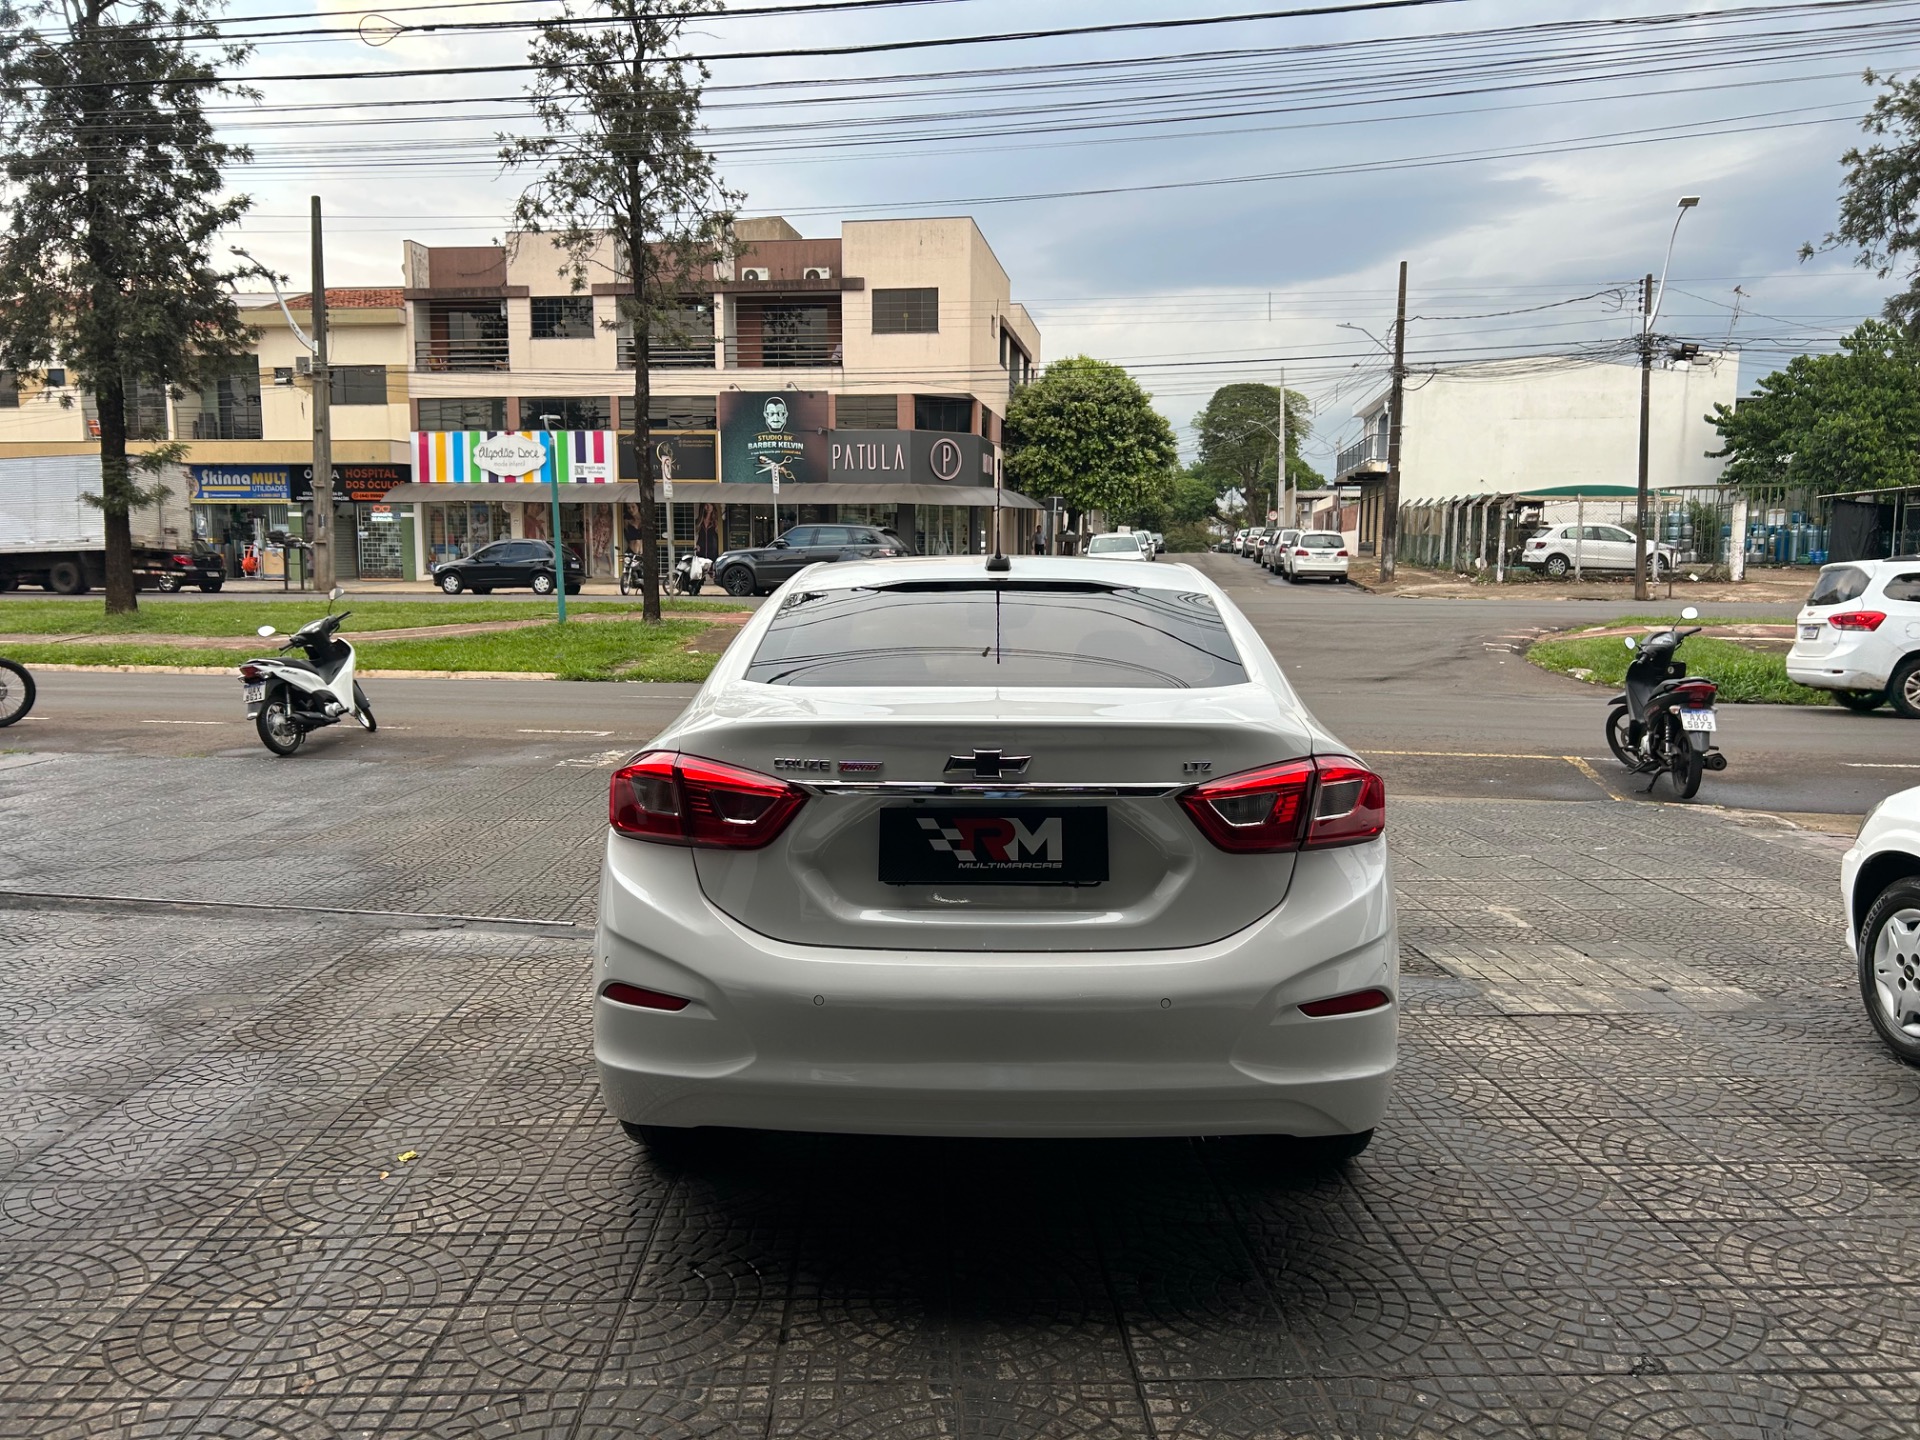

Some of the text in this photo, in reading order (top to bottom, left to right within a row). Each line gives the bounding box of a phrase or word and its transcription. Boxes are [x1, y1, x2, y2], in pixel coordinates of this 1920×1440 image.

[748, 441, 803, 450] BARBER KELVIN
[479, 446, 540, 460] Algodão Doce
[832, 443, 905, 471] PATULA
[942, 445, 951, 473] P
[345, 469, 398, 478] HOSPITAL
[345, 480, 366, 489] DOS
[774, 757, 831, 771] CRUZE
[1183, 761, 1213, 772] LTZ
